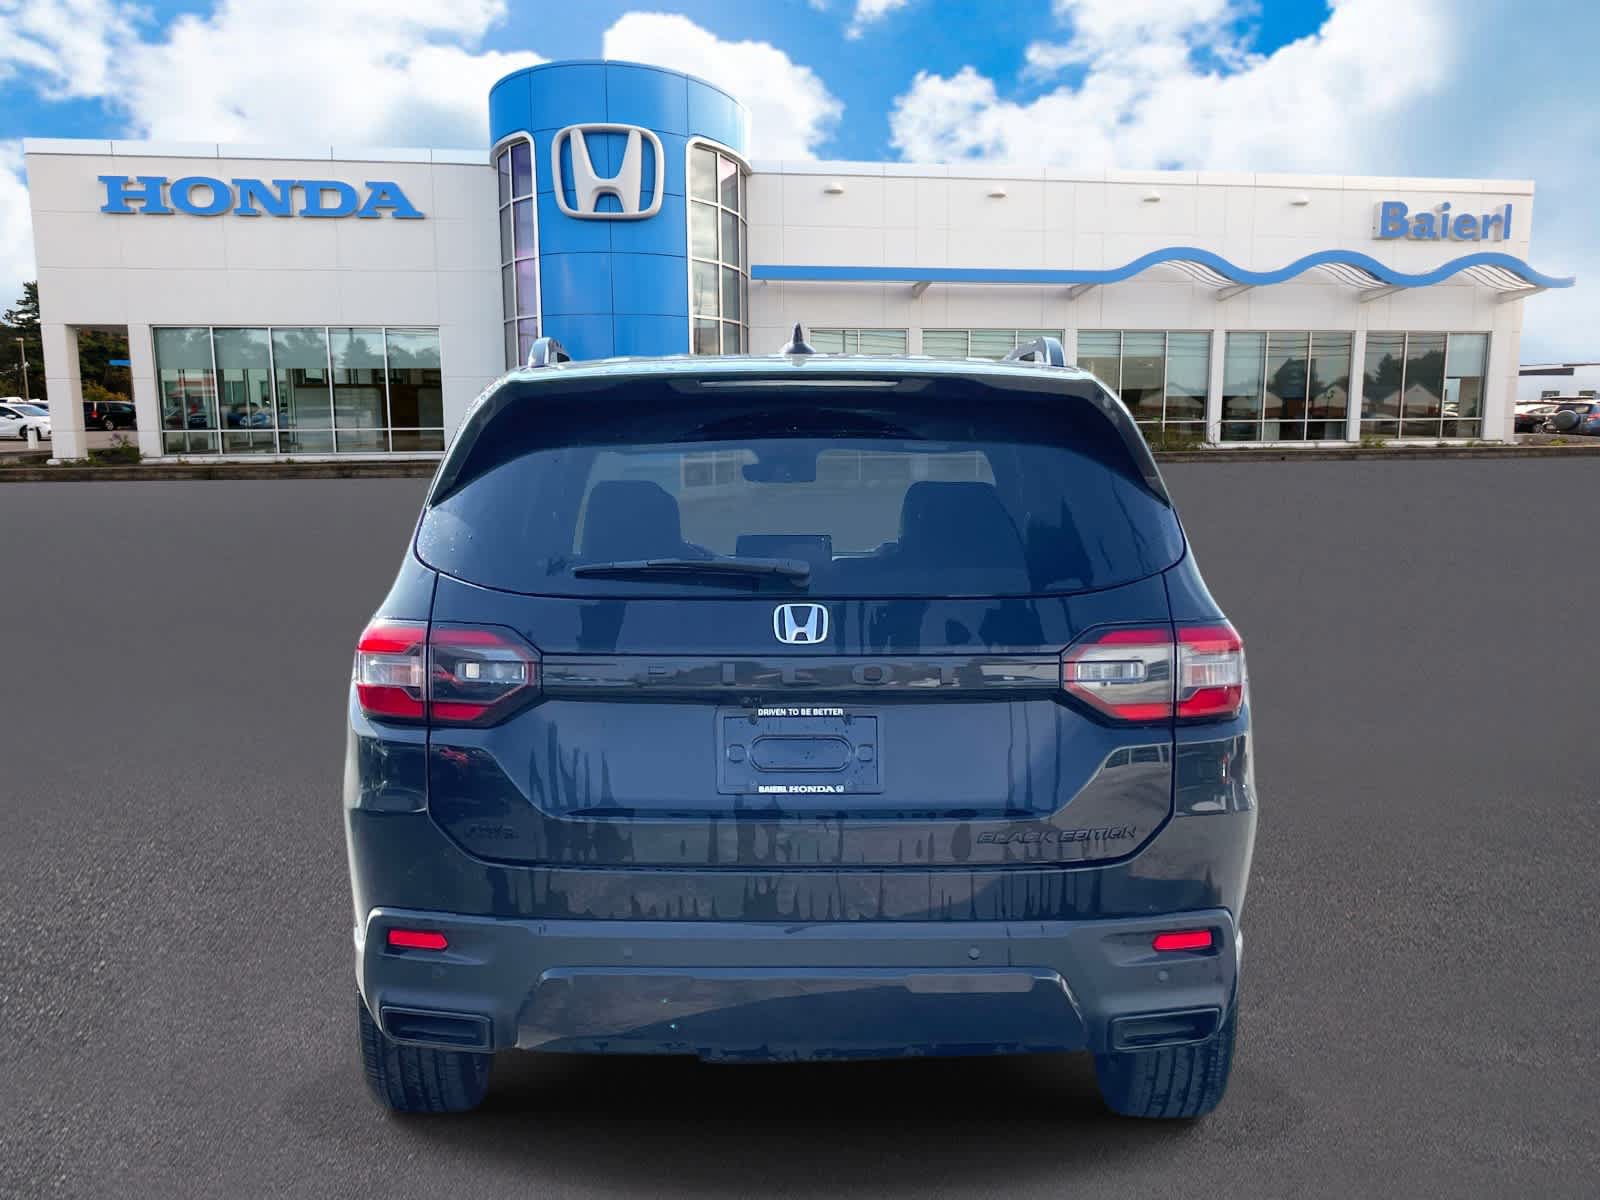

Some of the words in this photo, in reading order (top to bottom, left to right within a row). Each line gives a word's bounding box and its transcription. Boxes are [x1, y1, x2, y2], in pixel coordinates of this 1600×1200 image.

[98, 175, 425, 219] HONDA
[1378, 201, 1513, 240] Baierl
[647, 663, 962, 686] PILOT
[757, 708, 786, 716] DRIVEN
[788, 708, 800, 716] TO
[801, 708, 812, 716] BE
[813, 708, 844, 716] BETTER
[789, 785, 836, 793] HONDA
[977, 831, 1054, 844] BLACK
[1057, 826, 1137, 844] EDITION
